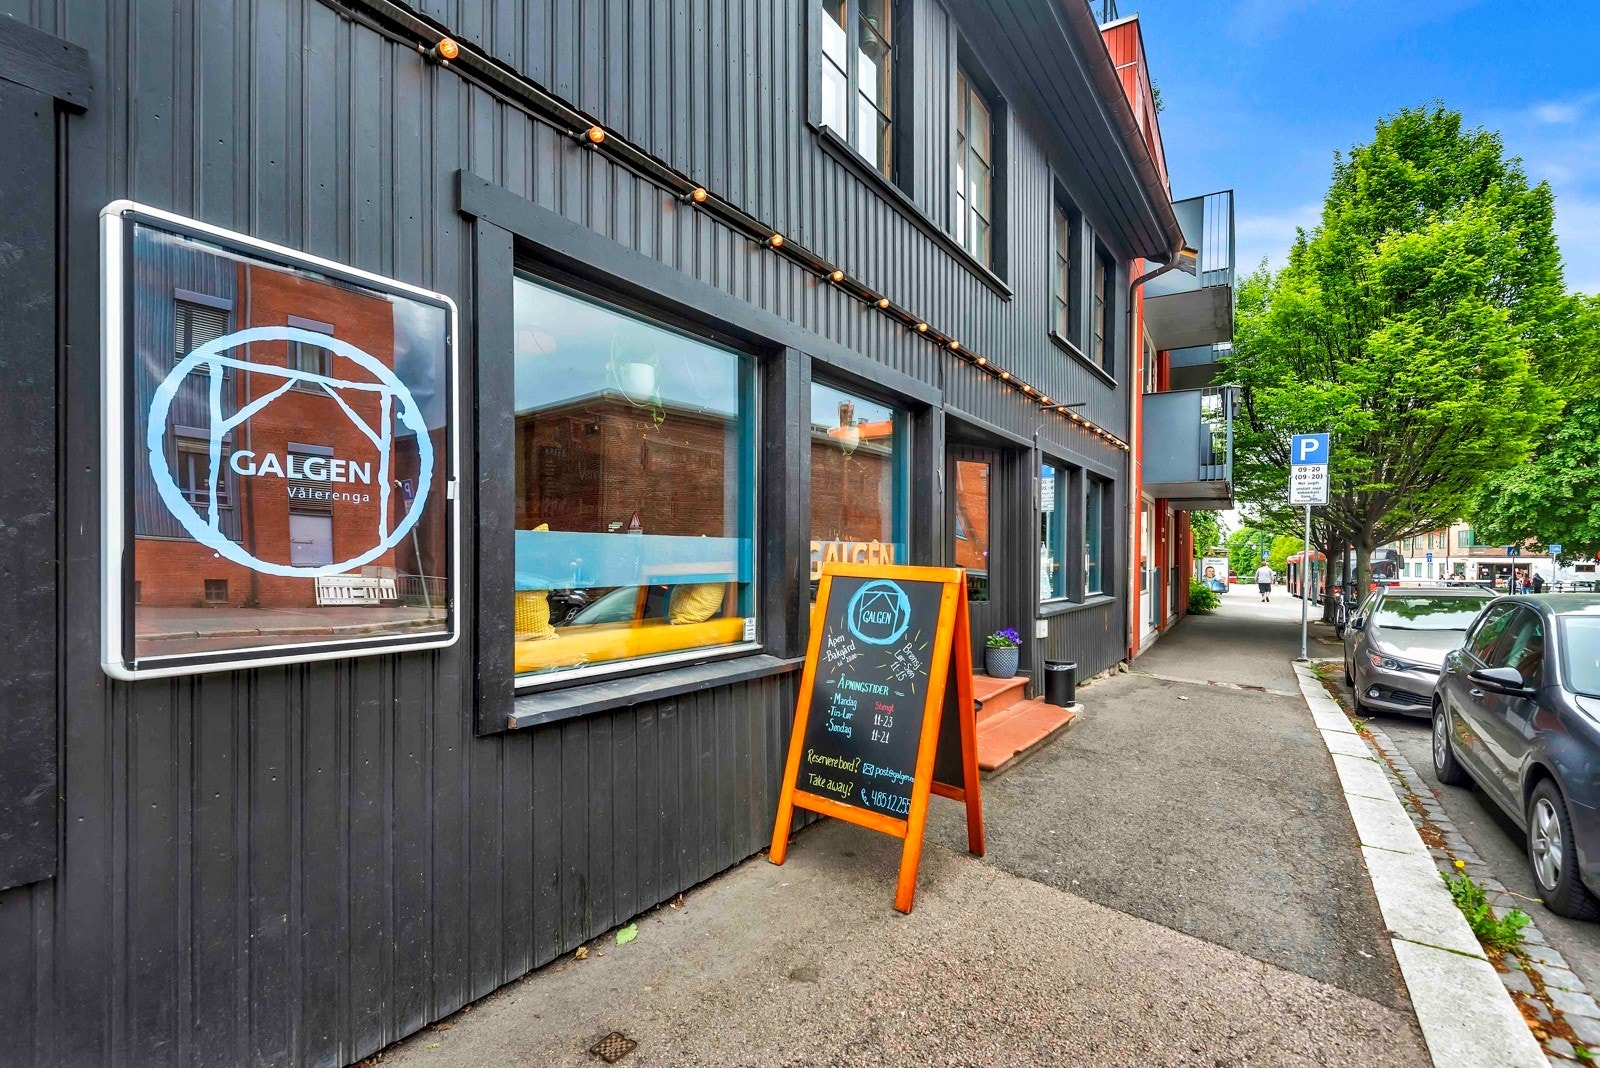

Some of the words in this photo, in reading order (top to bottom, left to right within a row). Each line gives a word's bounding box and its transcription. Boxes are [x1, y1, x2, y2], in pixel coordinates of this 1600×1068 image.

[1300, 438, 1319, 461] P
[229, 450, 371, 485] GALGEN
[286, 486, 370, 504] Vålerenga
[862, 610, 892, 625] GALGEN
[826, 639, 856, 662] Bakgård
[828, 634, 845, 648] Åpen
[890, 661, 908, 681] 11-15
[837, 673, 889, 696] ÅPNINGSTIDER
[834, 693, 857, 711] Mandag
[875, 701, 895, 715] Stengt
[828, 718, 852, 738] Søndag
[874, 713, 893, 728] 11-23
[871, 729, 890, 744] 11-21
[809, 773, 826, 788] Take
[826, 780, 854, 799] away?
